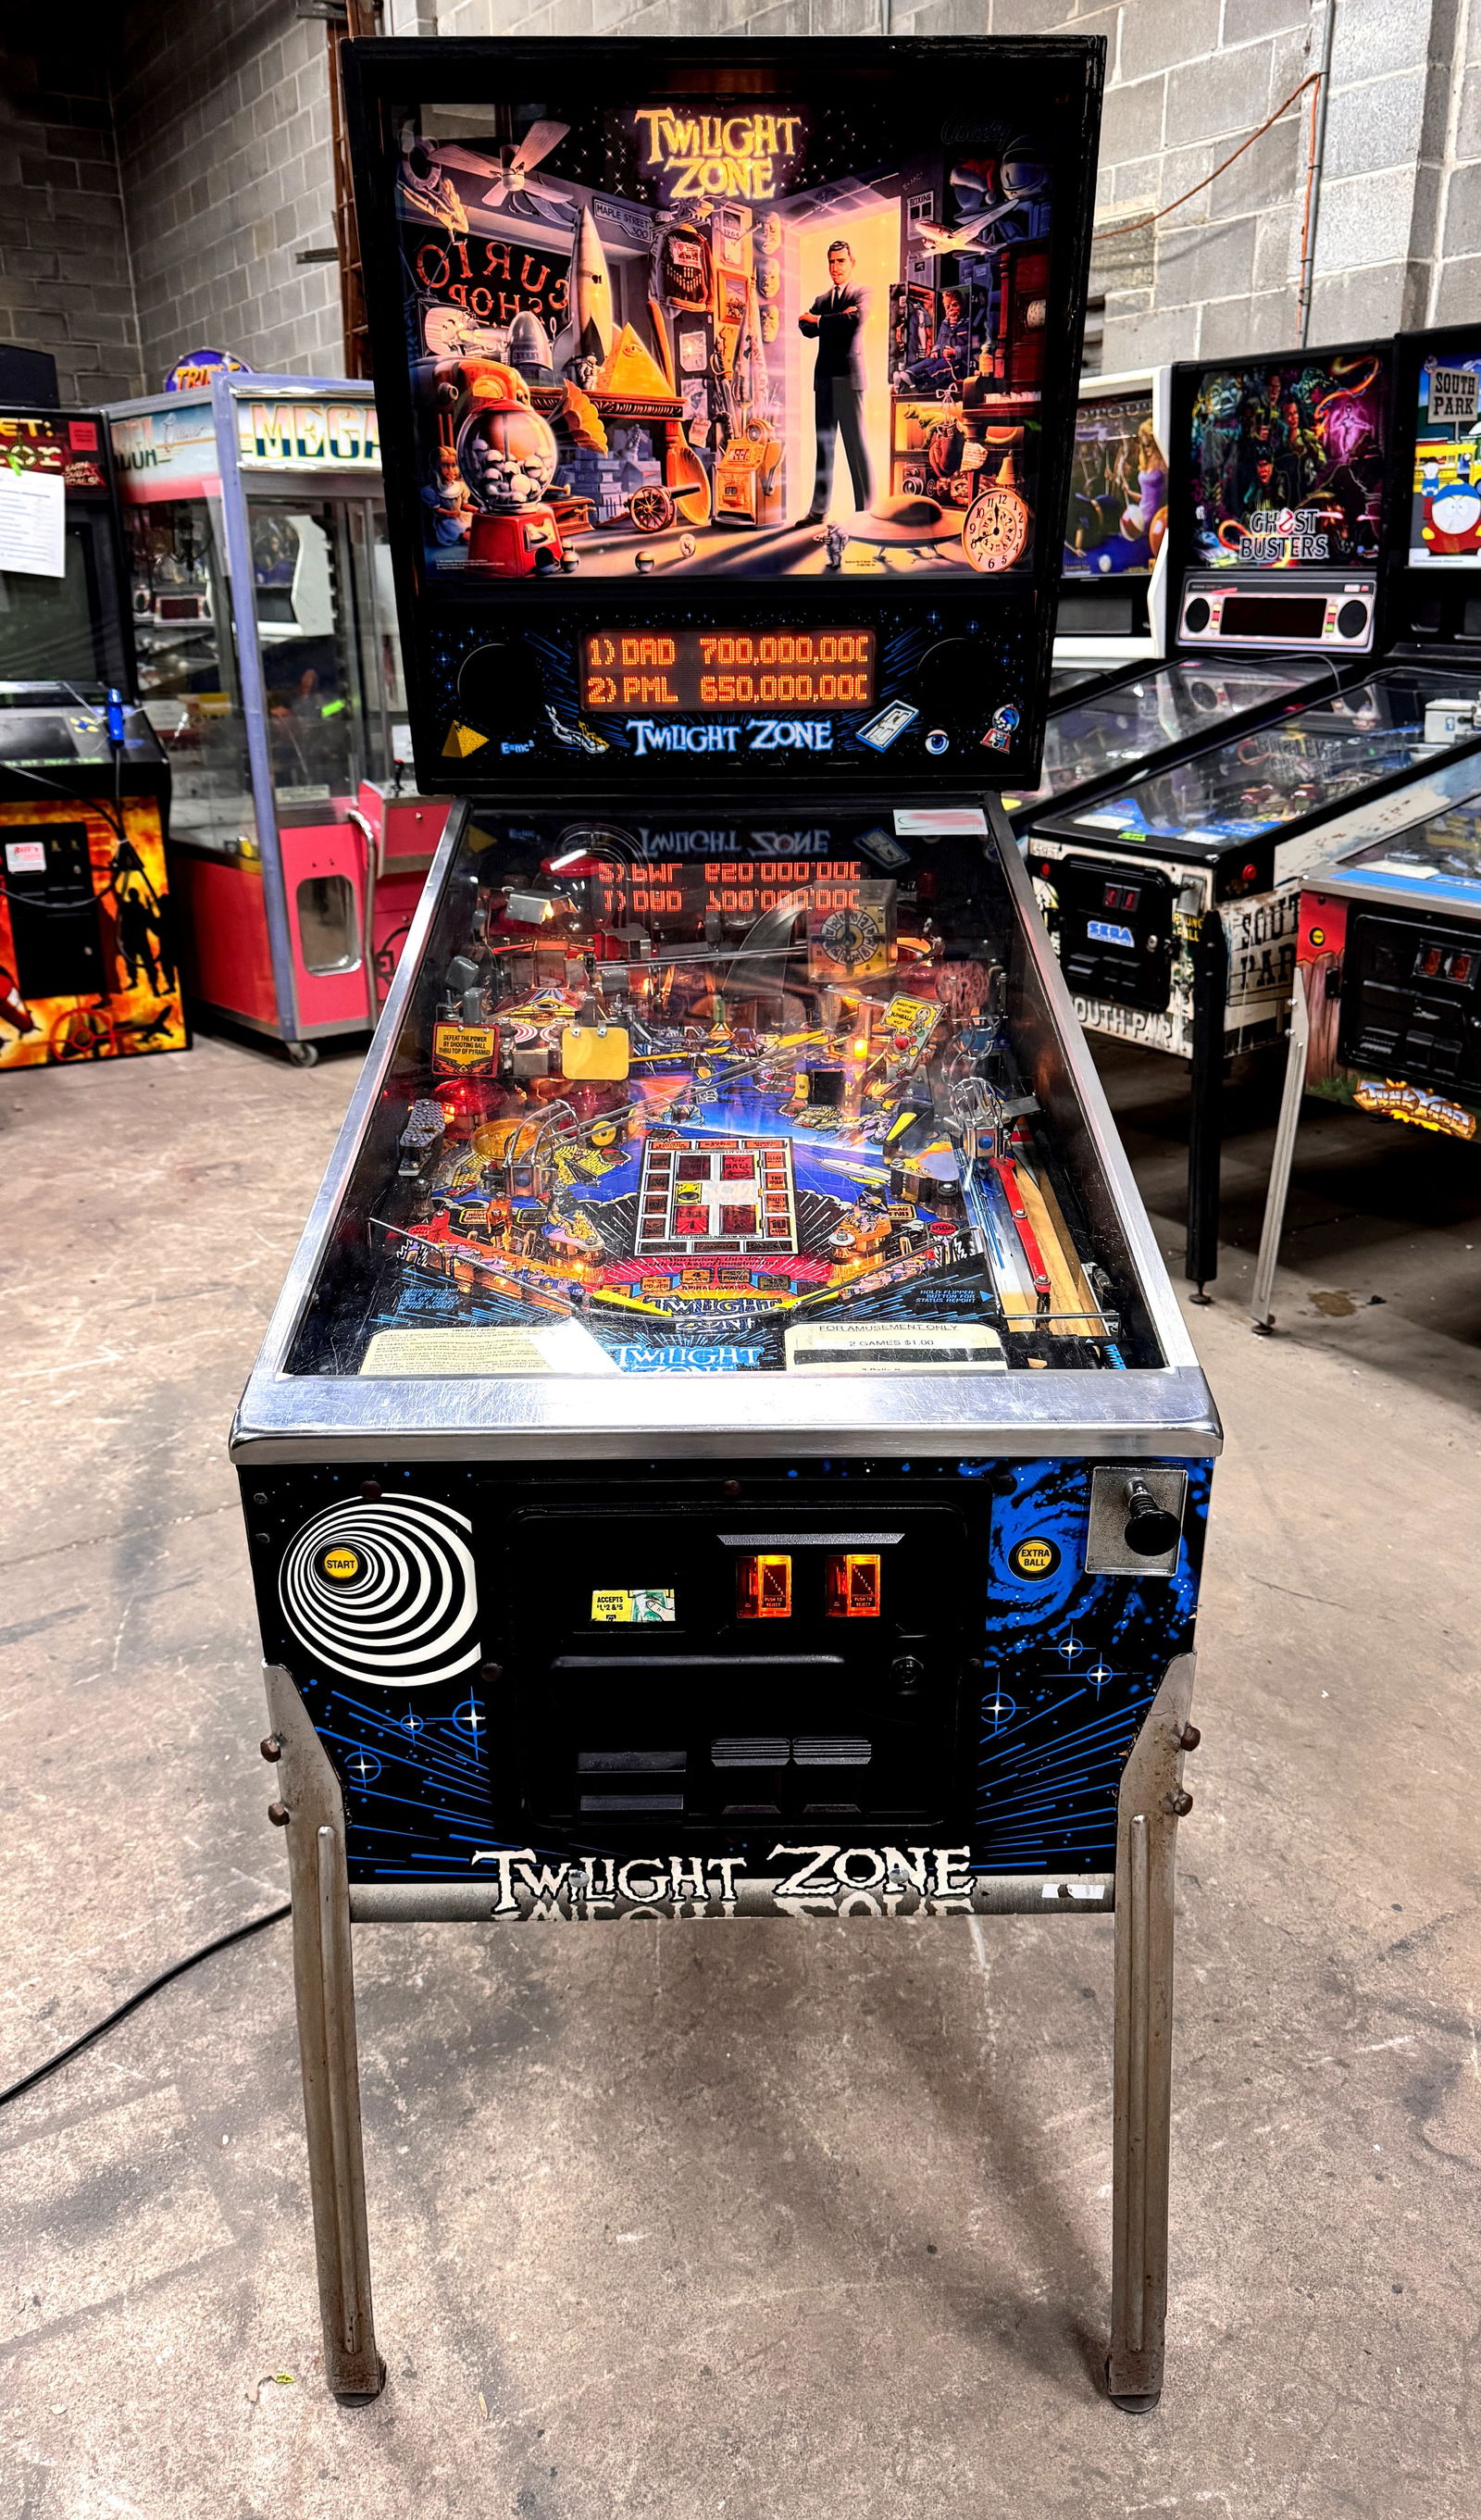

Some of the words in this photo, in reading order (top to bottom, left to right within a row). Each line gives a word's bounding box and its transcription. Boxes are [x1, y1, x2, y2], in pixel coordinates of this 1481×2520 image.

[634, 107, 802, 164] TWILIGHT
[664, 156, 776, 200] ZONE
[597, 204, 621, 219] MAPLE
[624, 214, 648, 229] STREET
[1436, 372, 1475, 395] SOUTH
[1434, 396, 1474, 416] PARK
[1238, 534, 1330, 560] BUSTERS
[590, 638, 616, 666] 1)
[621, 638, 676, 666] DAD
[587, 676, 616, 705] 2)
[622, 676, 678, 705] PML
[626, 718, 741, 756] TWILIGHT
[746, 718, 834, 752] ZONE
[1089, 922, 1132, 942] SEGA
[1240, 943, 1297, 991] PAR
[1074, 997, 1126, 1035] OUTH
[606, 1345, 763, 1366] TWILIGHT
[327, 1559, 355, 1569] START
[1021, 1549, 1050, 1557] EXTRA
[471, 1848, 747, 1914] TWILIGHT
[766, 1843, 977, 1898] ZONE
